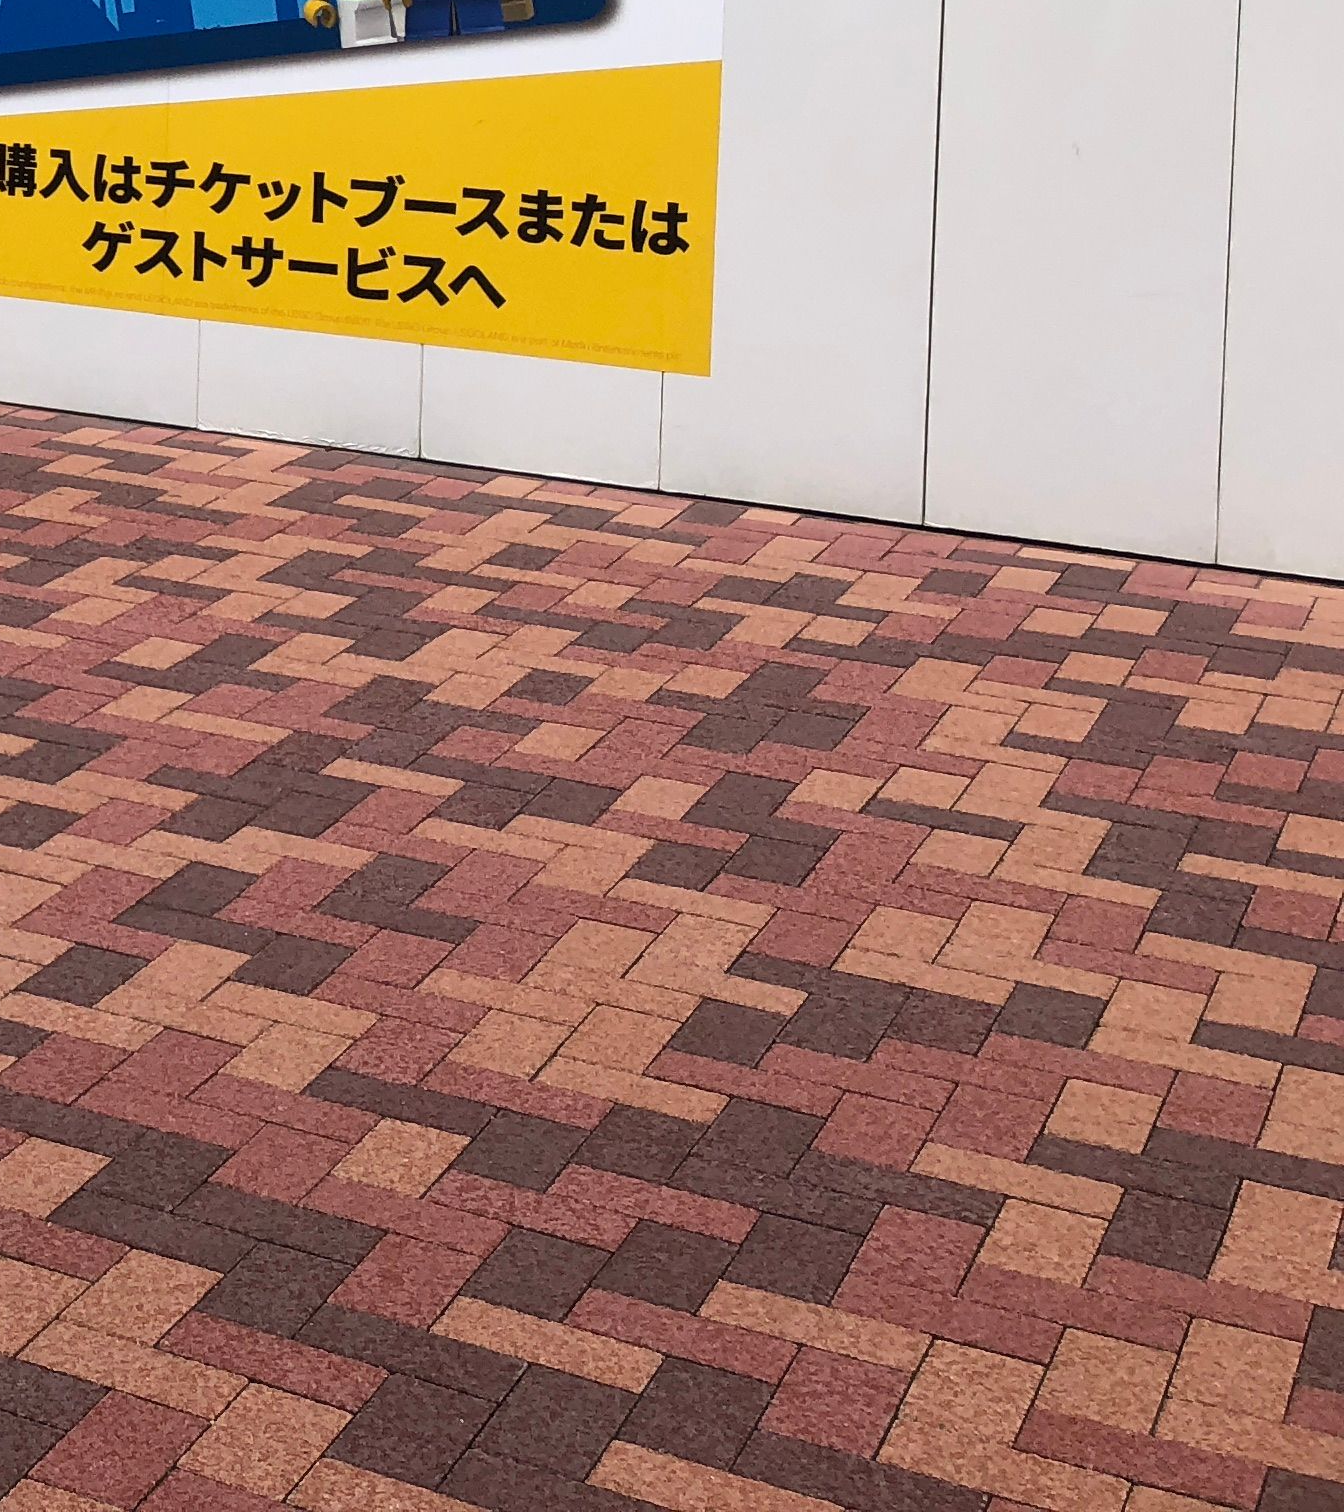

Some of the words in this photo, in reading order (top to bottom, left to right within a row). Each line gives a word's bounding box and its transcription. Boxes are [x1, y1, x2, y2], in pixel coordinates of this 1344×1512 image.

[82, 219, 509, 310] ゲストサービスへ
